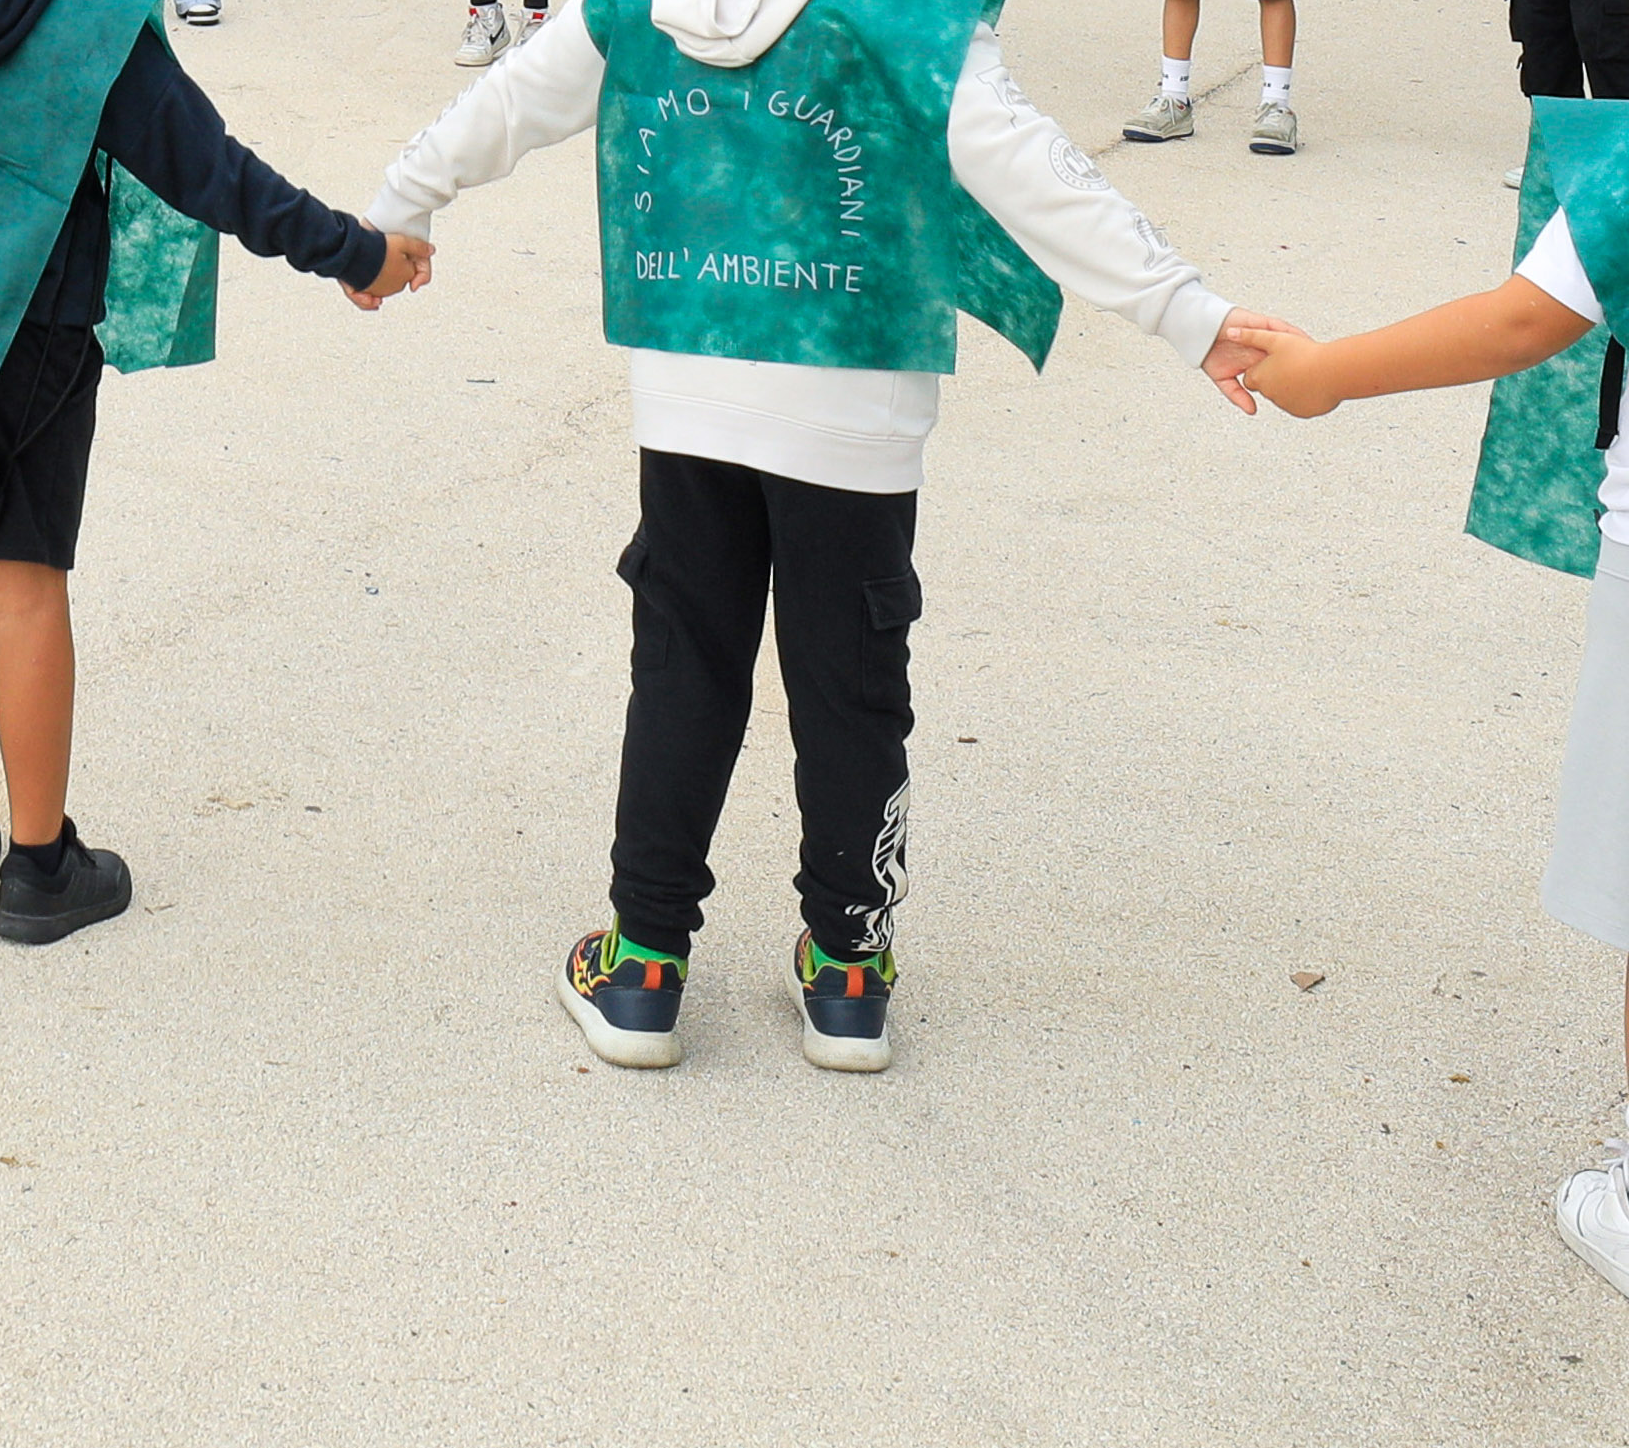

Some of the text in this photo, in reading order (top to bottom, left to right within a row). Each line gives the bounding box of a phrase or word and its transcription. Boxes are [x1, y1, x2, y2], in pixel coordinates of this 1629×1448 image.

[634, 88, 865, 237] SIAMO I GUARDIANI
